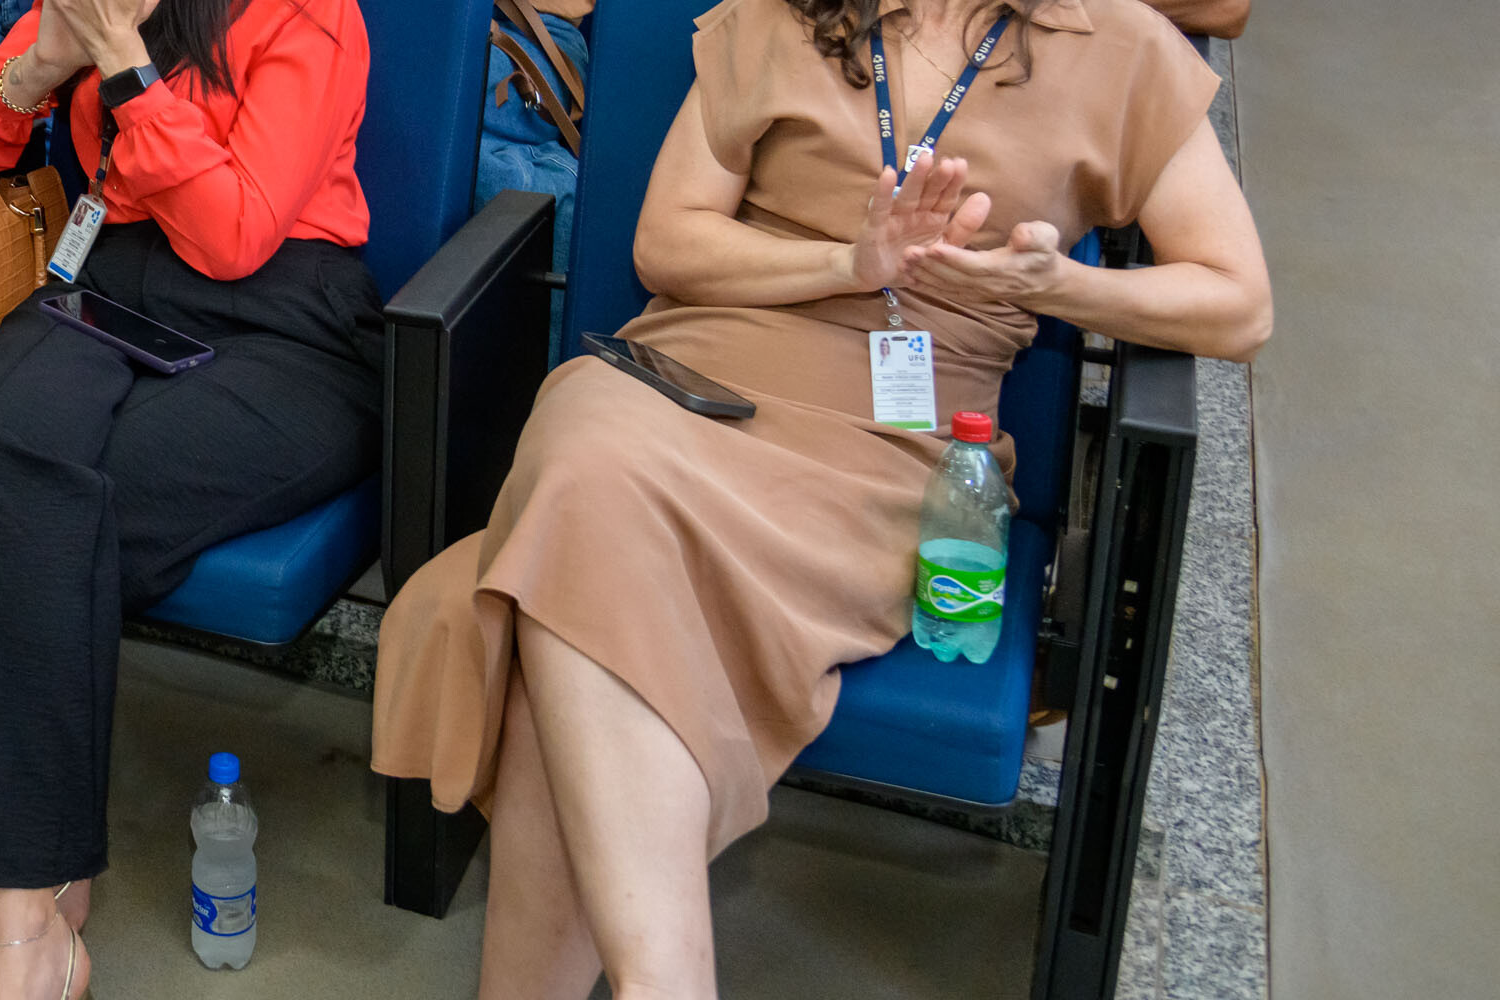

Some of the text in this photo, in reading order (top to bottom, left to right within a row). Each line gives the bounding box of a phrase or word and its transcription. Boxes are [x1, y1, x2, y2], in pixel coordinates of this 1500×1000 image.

[978, 37, 996, 54] UFG
[874, 63, 886, 82] UFG
[949, 85, 966, 104] UFG
[881, 118, 892, 138] UFG
[908, 354, 926, 362] UFG
